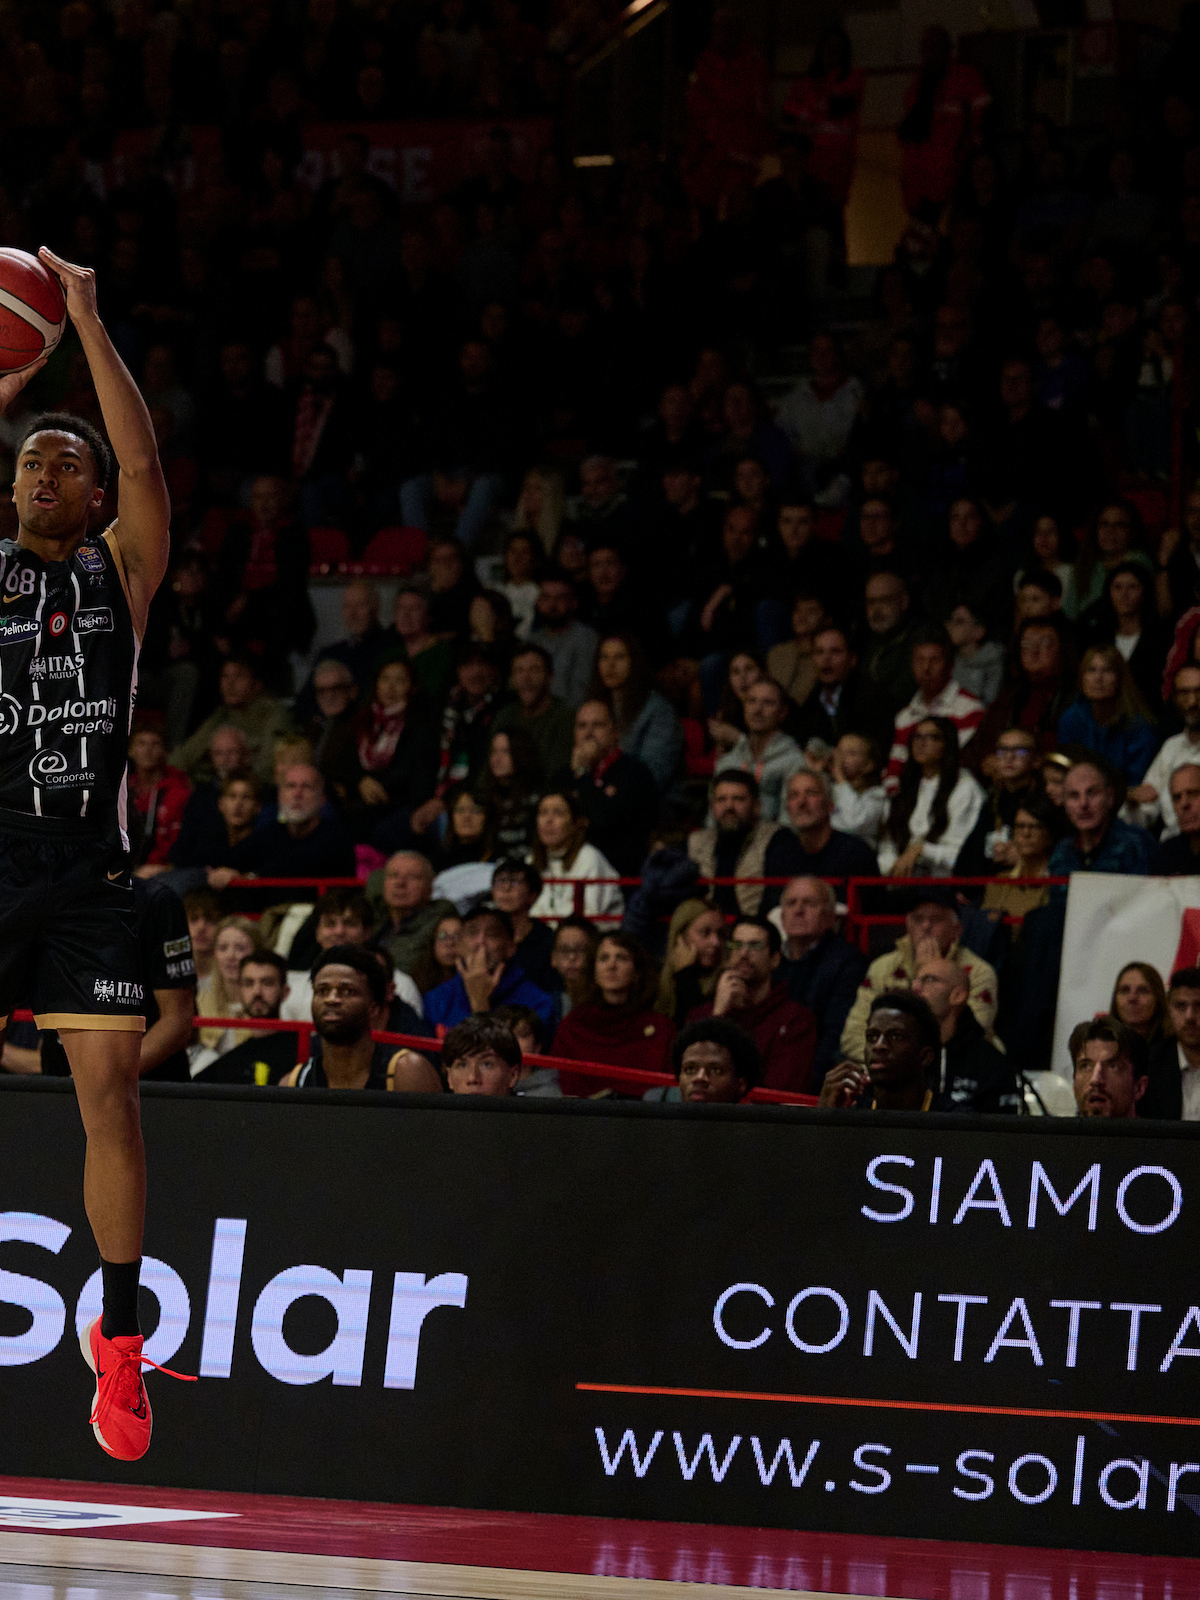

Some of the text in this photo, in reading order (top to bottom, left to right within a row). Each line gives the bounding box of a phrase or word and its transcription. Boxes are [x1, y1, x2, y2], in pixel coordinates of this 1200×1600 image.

[5, 562, 36, 594] 68
[77, 616, 108, 628] TRENTO
[48, 653, 84, 672] ITAS
[49, 671, 78, 680] MUTUA
[45, 772, 95, 784] Corporate
[117, 981, 144, 1000] ITAS
[861, 1154, 1184, 1234] SIAMO
[712, 1282, 1200, 1373] CONTATTA
[594, 1427, 1200, 1512] www.s-solar
